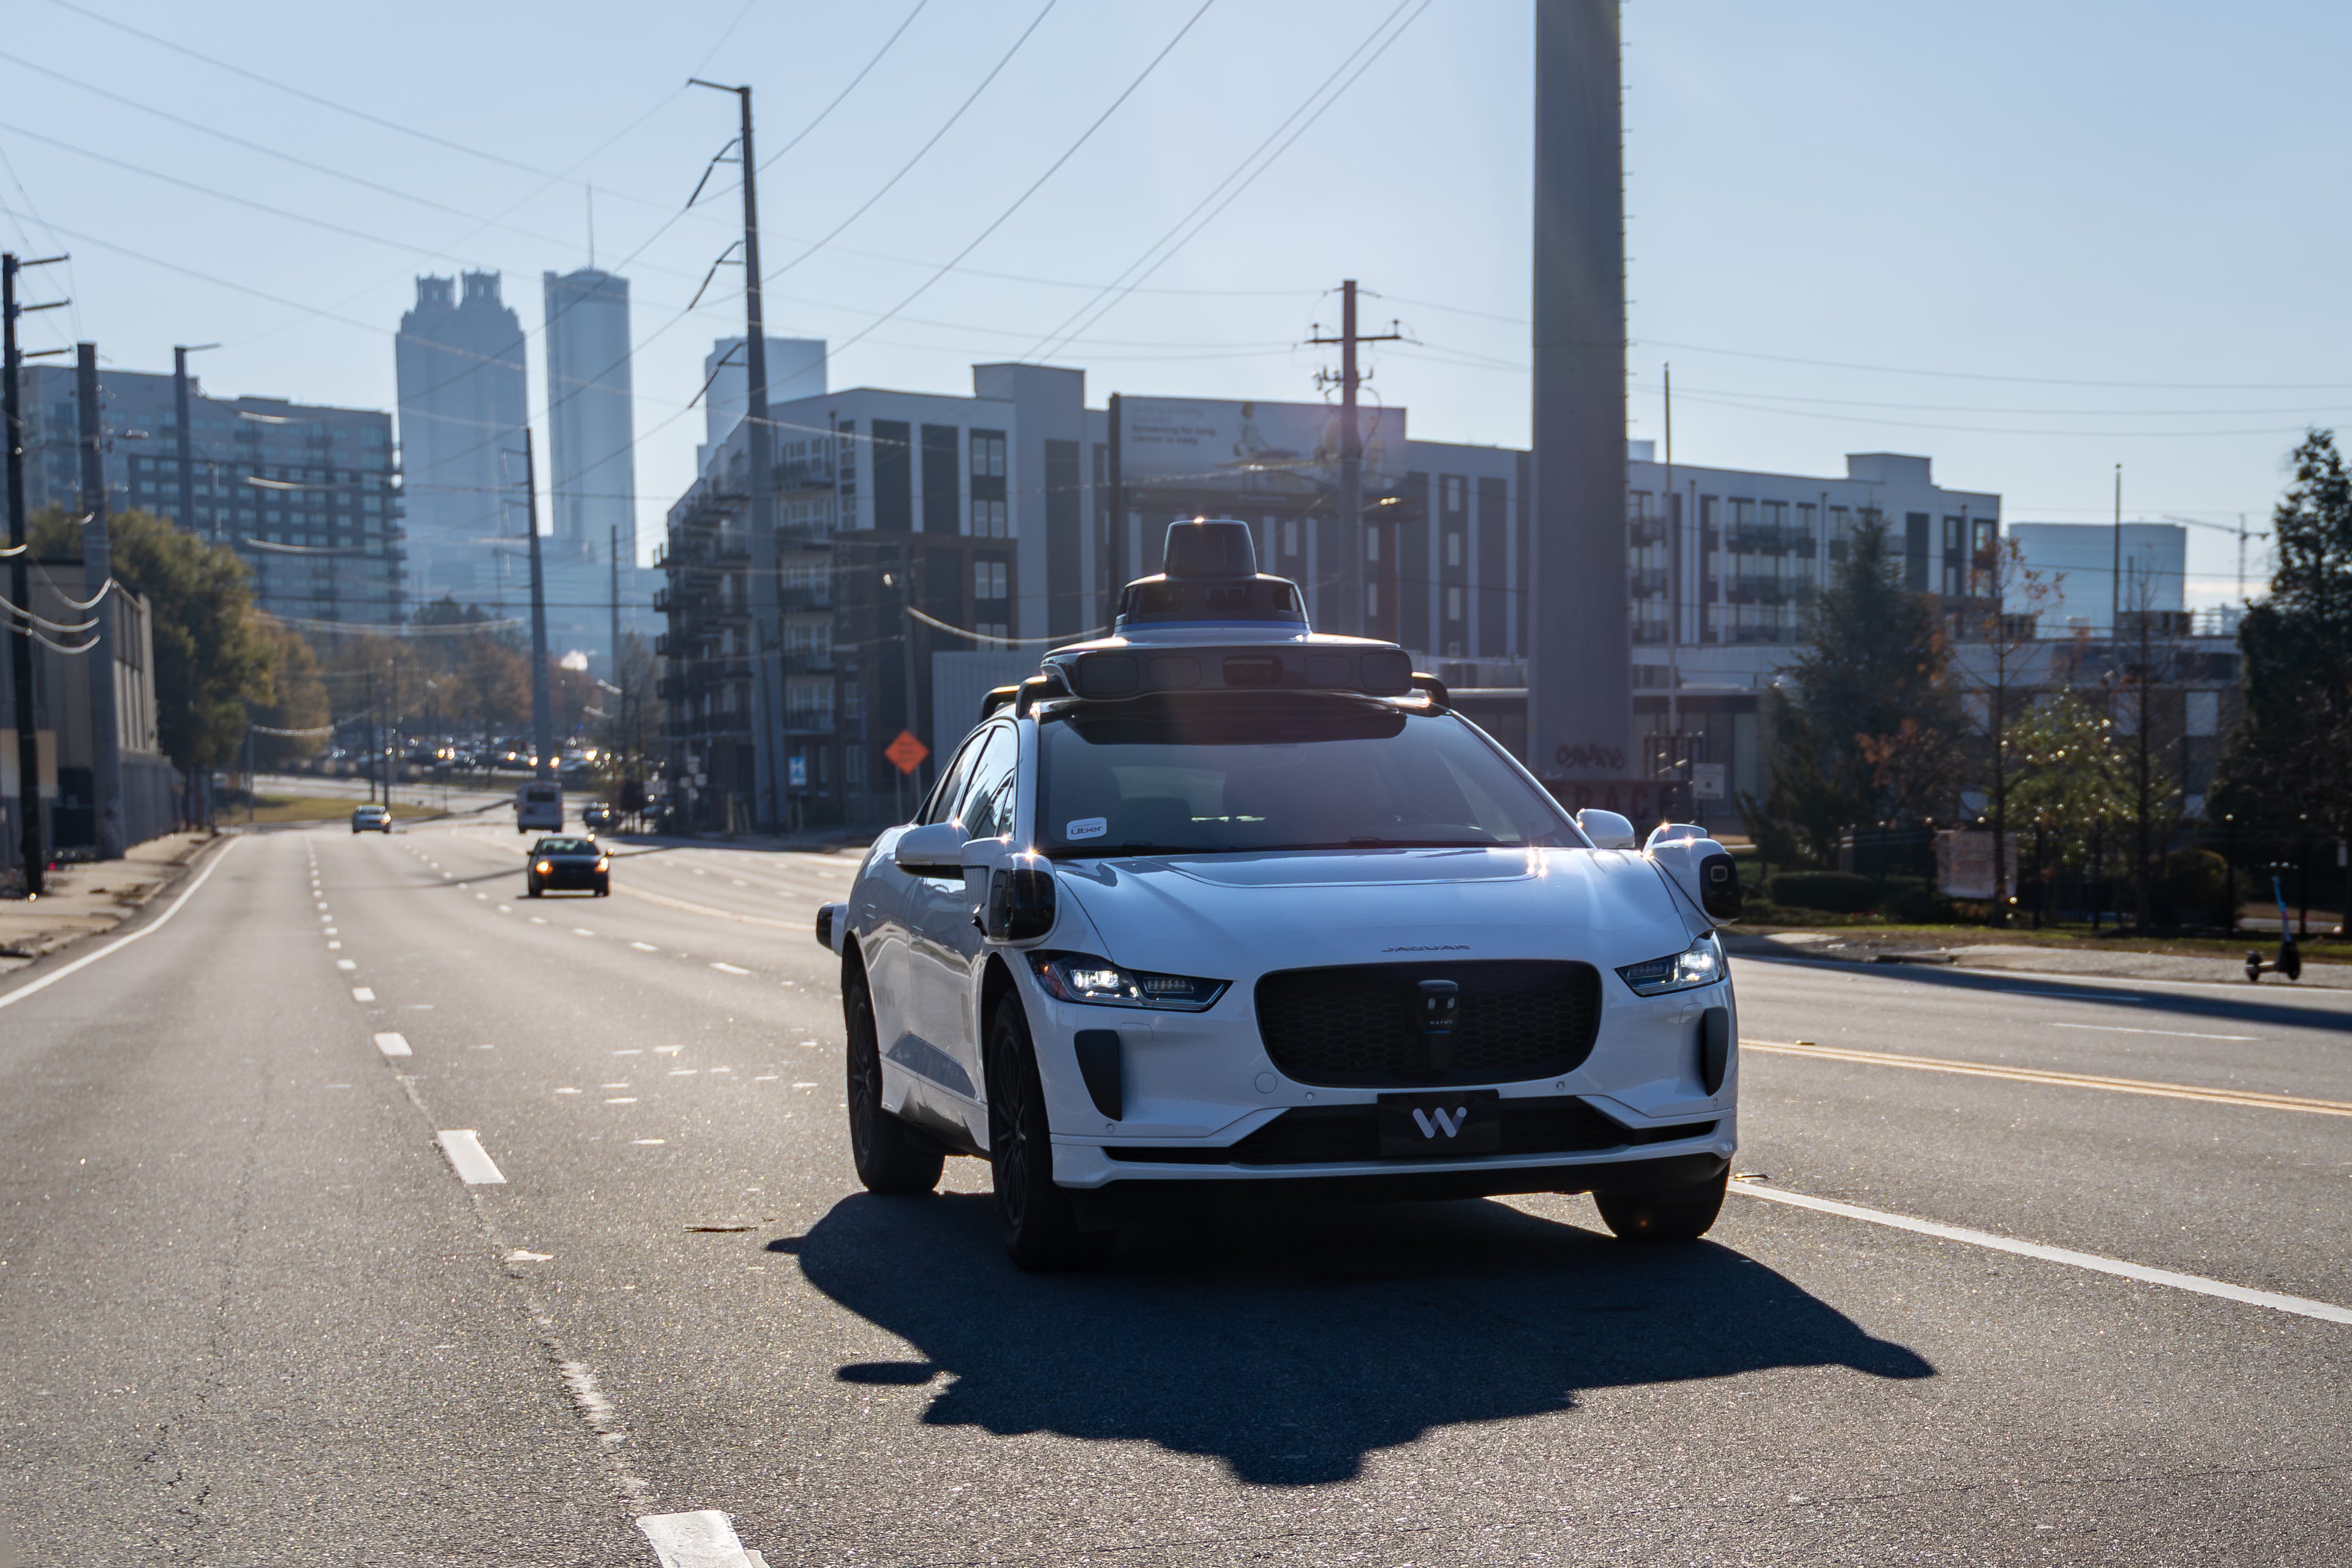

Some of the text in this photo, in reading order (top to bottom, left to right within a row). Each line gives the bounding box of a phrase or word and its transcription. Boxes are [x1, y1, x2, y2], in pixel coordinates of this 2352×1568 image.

[1132, 424, 1216, 437] Screening for lung
[1071, 826, 1102, 835] Uber
[1382, 944, 1471, 952] JAGUAR
